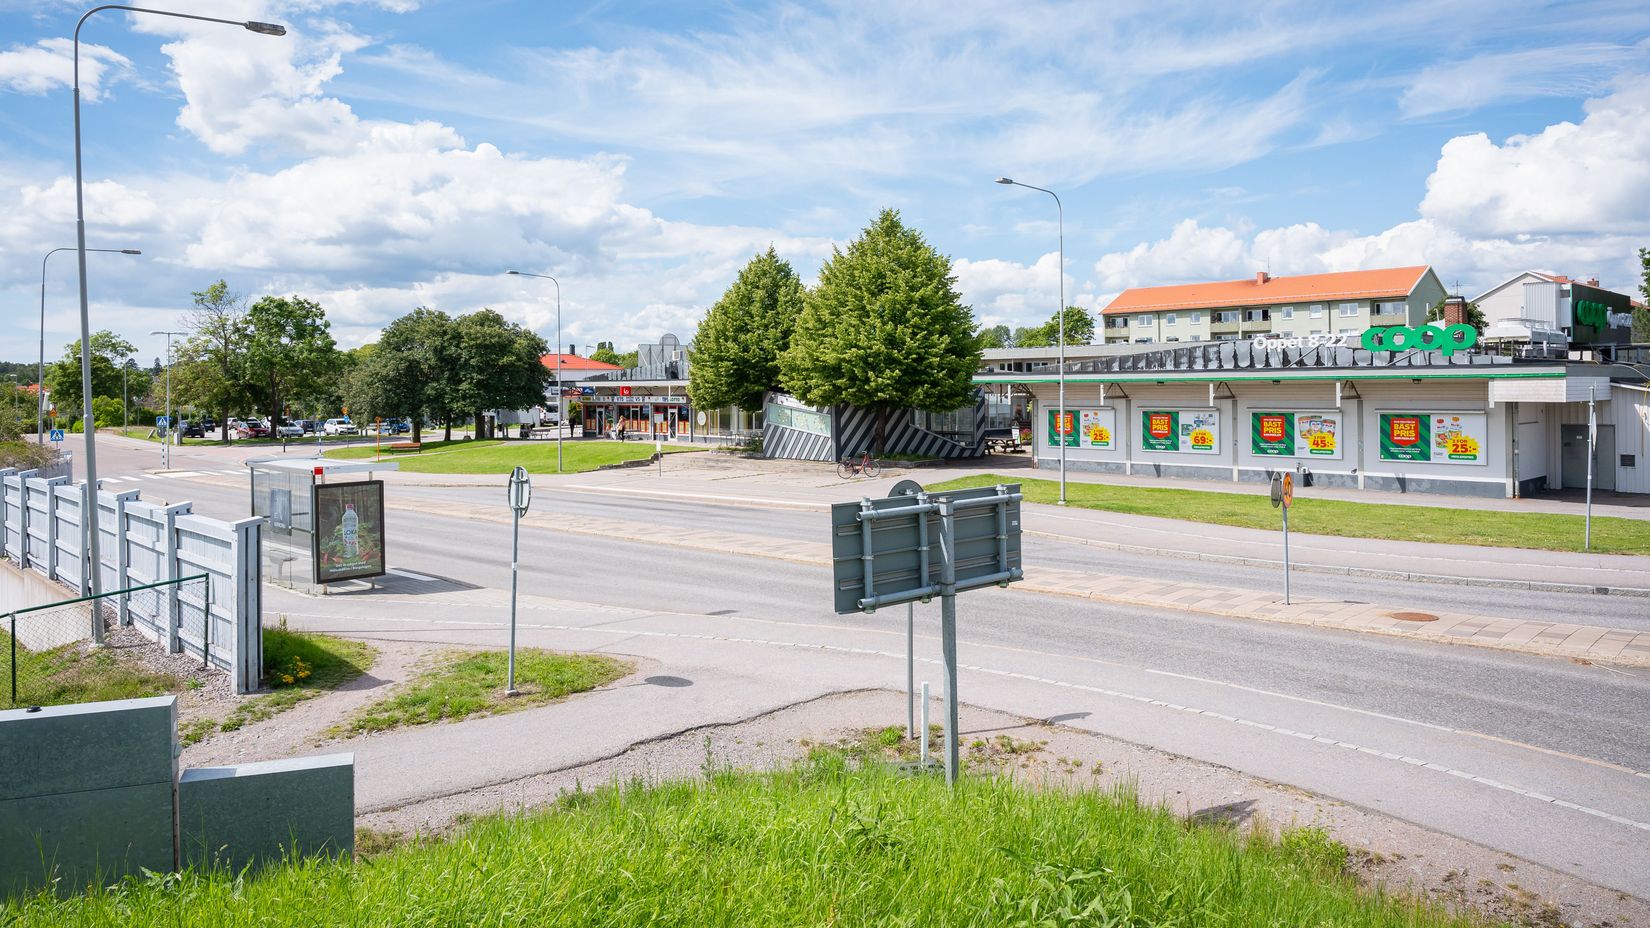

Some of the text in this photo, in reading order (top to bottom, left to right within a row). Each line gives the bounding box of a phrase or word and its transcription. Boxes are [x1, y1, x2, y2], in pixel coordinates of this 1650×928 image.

[1253, 333, 1348, 352] Öppet 8-22
[1361, 323, 1478, 356] coop
[1393, 429, 1416, 437] PRIS
[1451, 443, 1477, 453] 25:-
